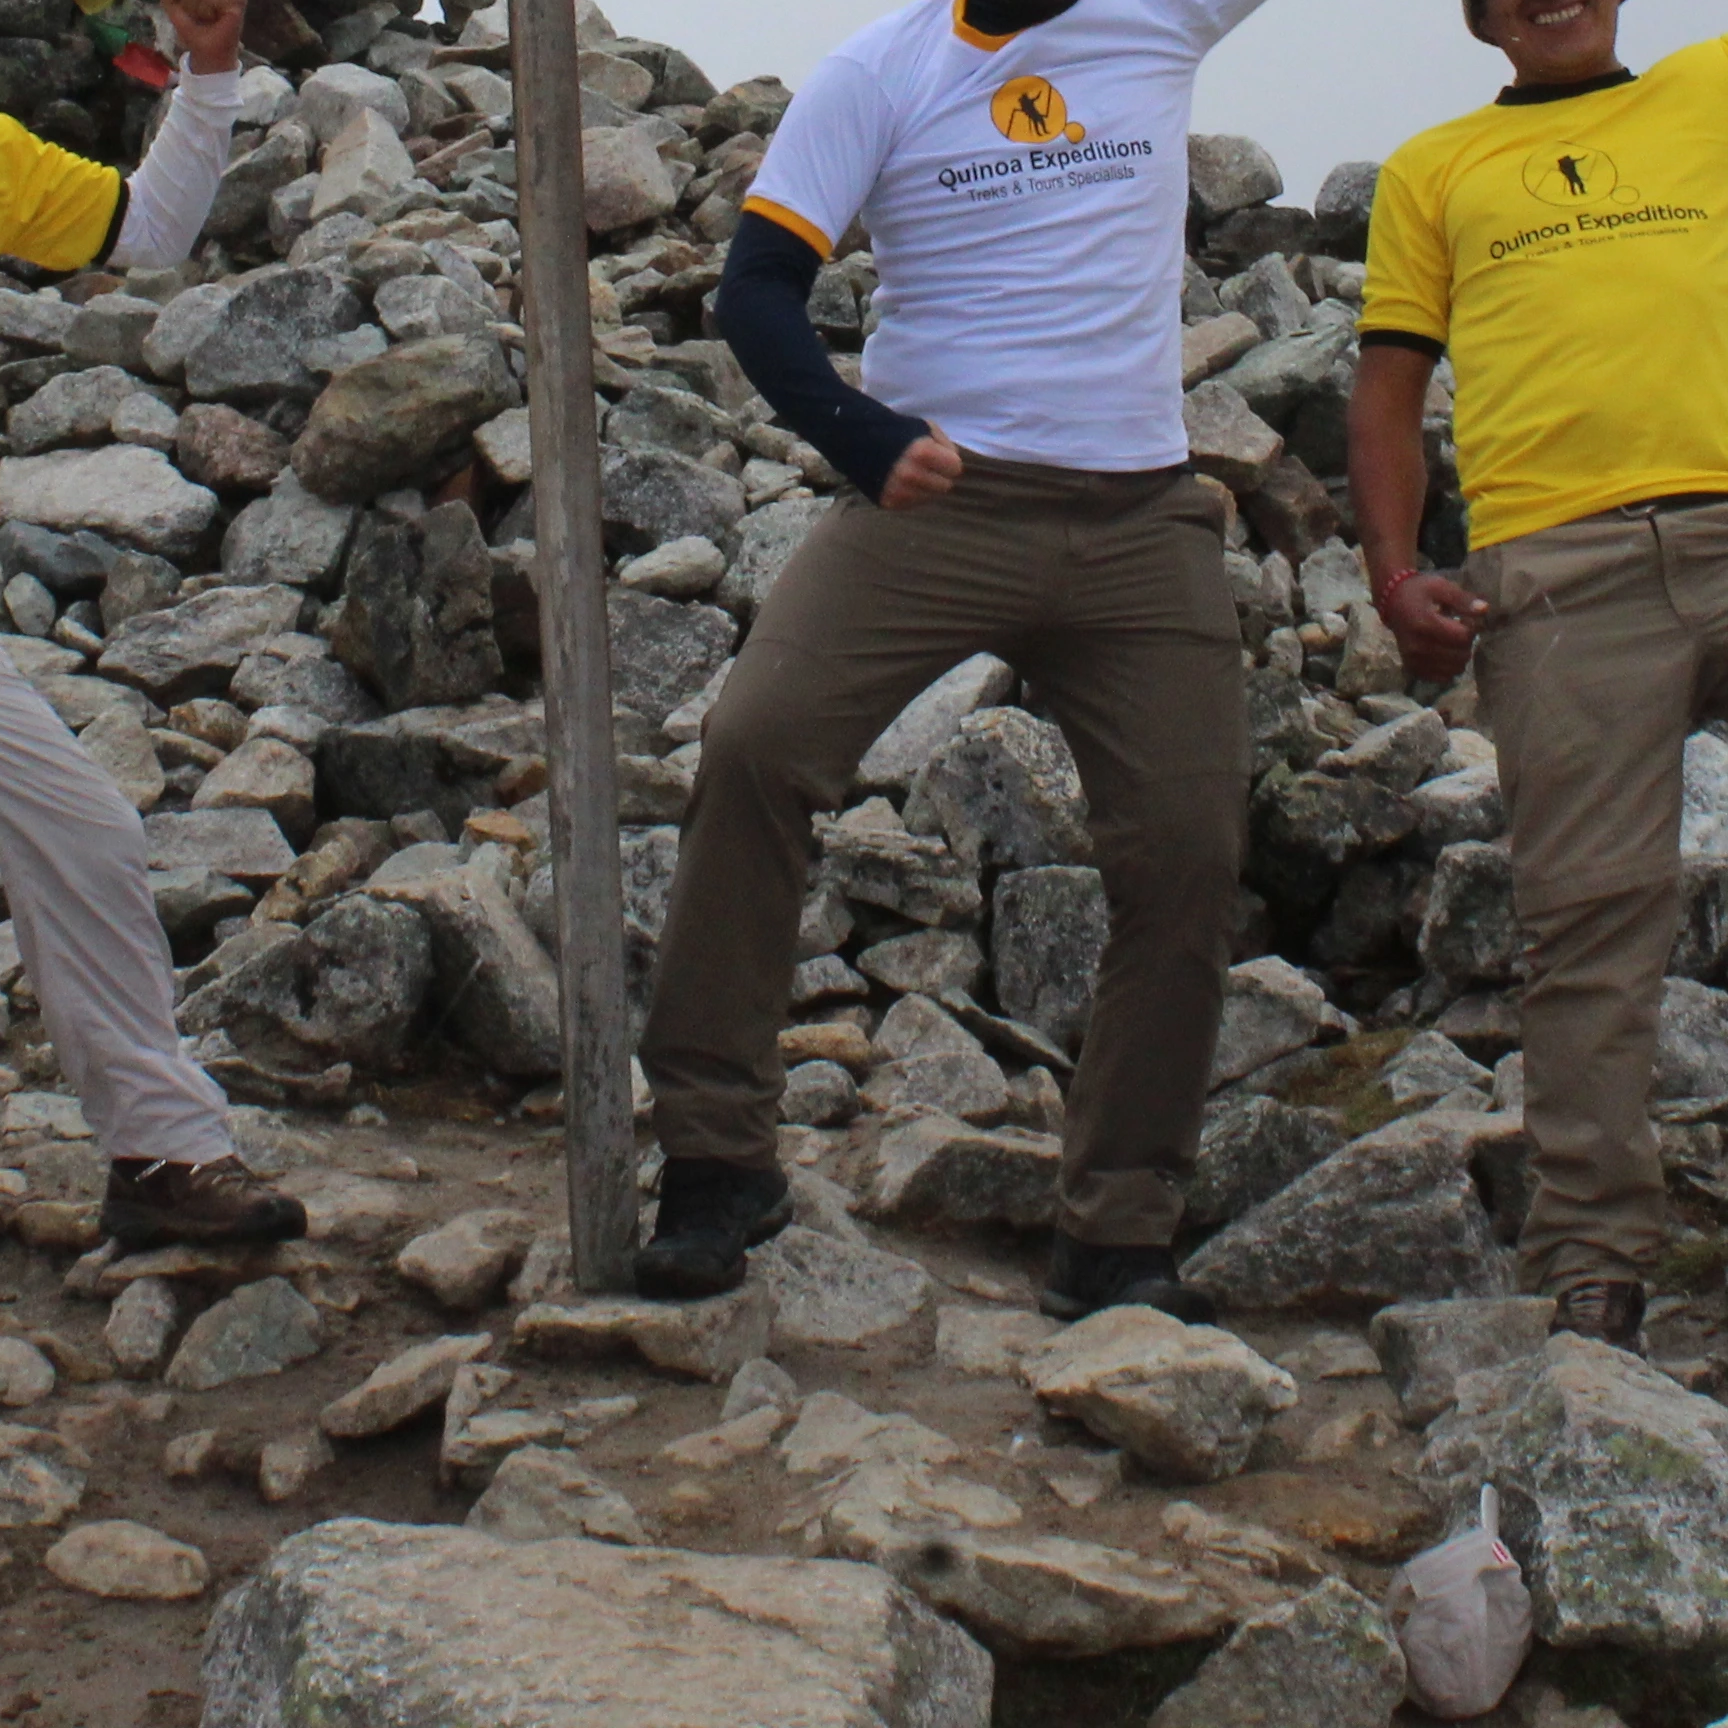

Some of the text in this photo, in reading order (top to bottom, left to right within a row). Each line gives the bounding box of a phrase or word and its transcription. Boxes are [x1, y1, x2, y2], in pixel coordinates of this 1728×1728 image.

[938, 138, 1152, 191] Quinoa Expeditions
[968, 164, 1135, 203] Treks & Tours Specialists
[1490, 204, 1708, 260] Quinoa Expeditions
